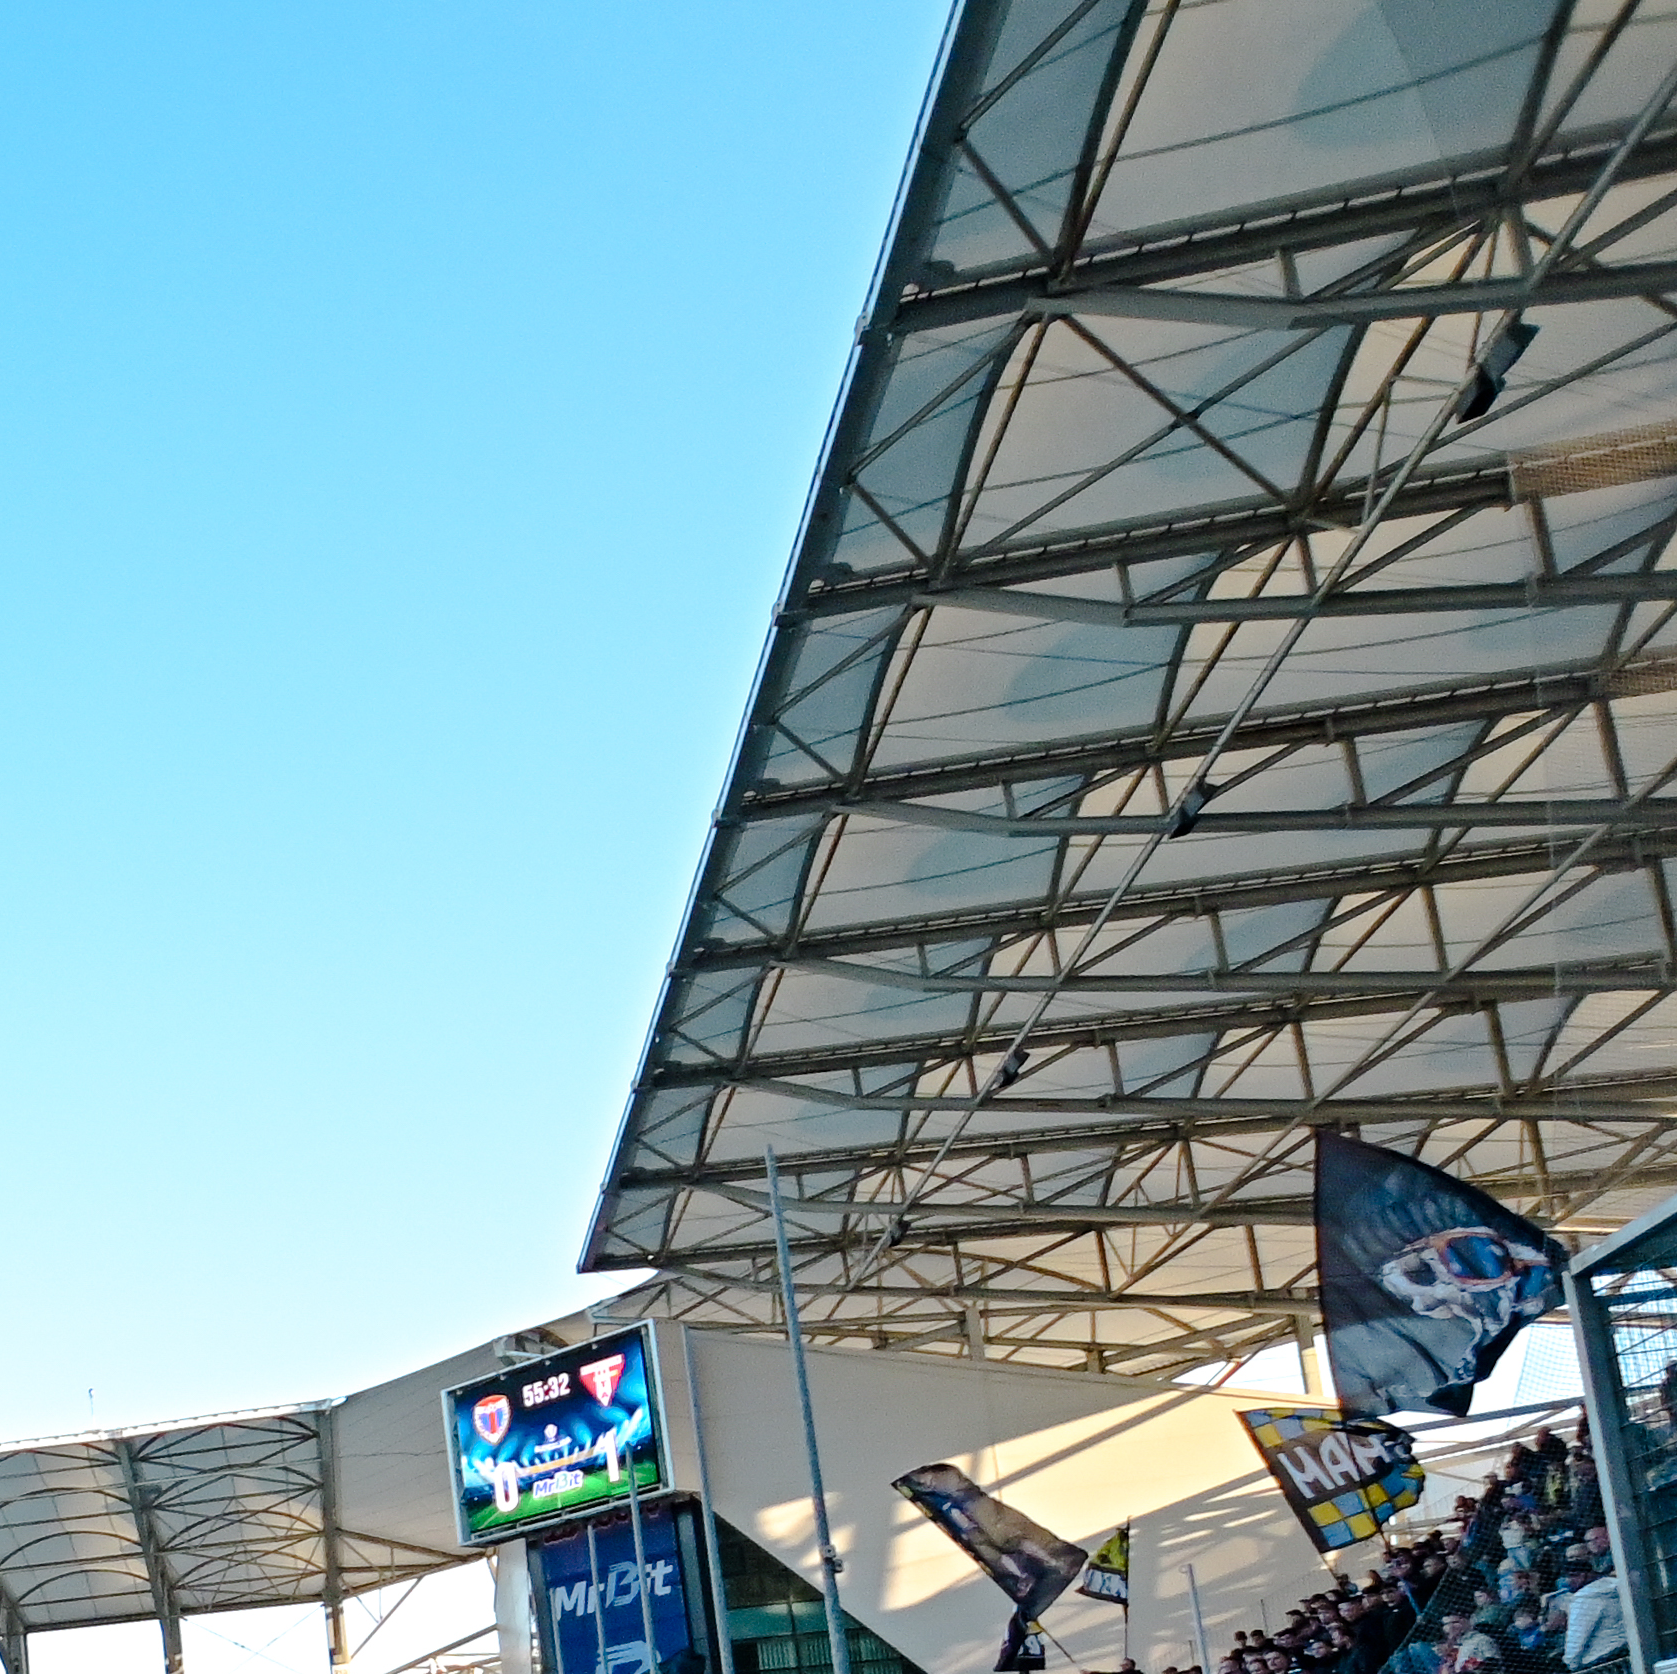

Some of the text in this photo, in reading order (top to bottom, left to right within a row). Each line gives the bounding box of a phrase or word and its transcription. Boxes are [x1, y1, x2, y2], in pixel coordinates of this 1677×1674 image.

[522, 1373, 571, 1408] 55:32
[596, 1426, 620, 1482] 1
[496, 1461, 519, 1512] 0
[534, 1471, 583, 1496] MrBit
